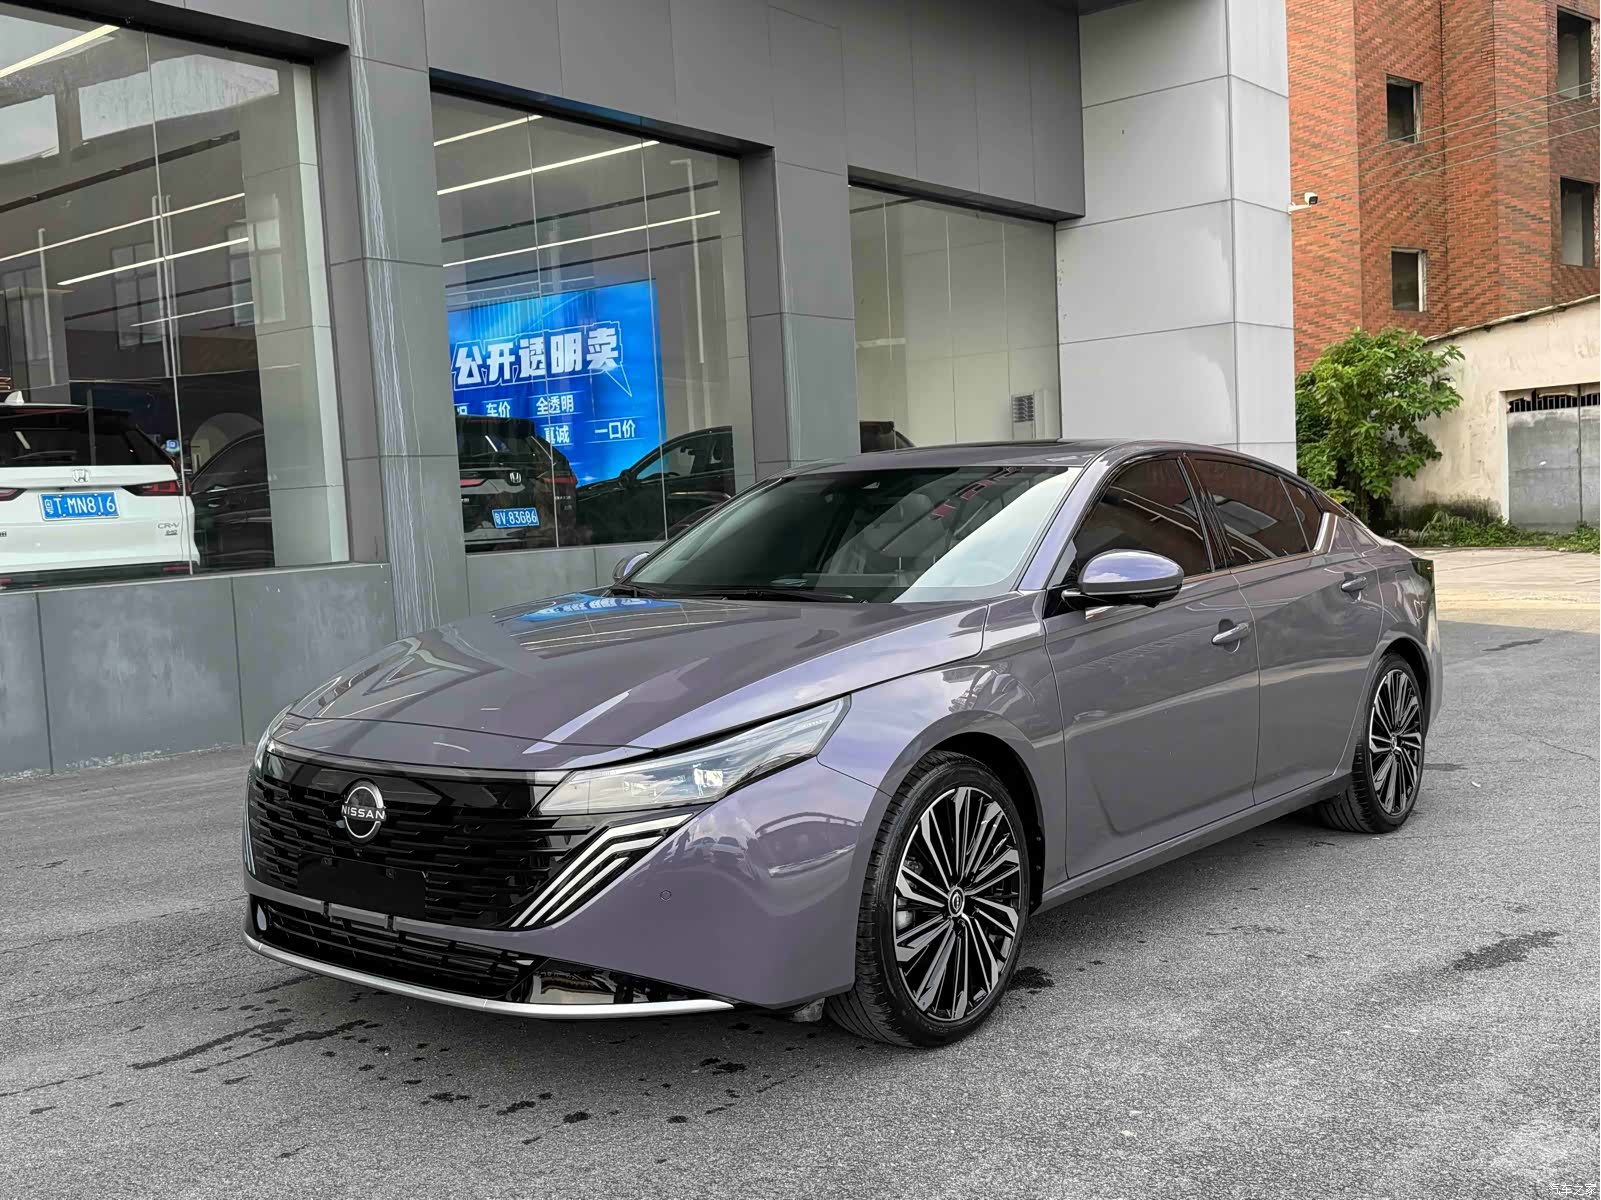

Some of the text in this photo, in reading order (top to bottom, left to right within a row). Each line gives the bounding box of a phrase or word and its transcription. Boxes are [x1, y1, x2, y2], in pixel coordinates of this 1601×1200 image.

[455, 327, 618, 385] 公开透明卖
[486, 401, 511, 418] 车价
[536, 394, 574, 415] 全透明
[594, 419, 636, 439] 一口价
[341, 804, 386, 820] NISSAN
